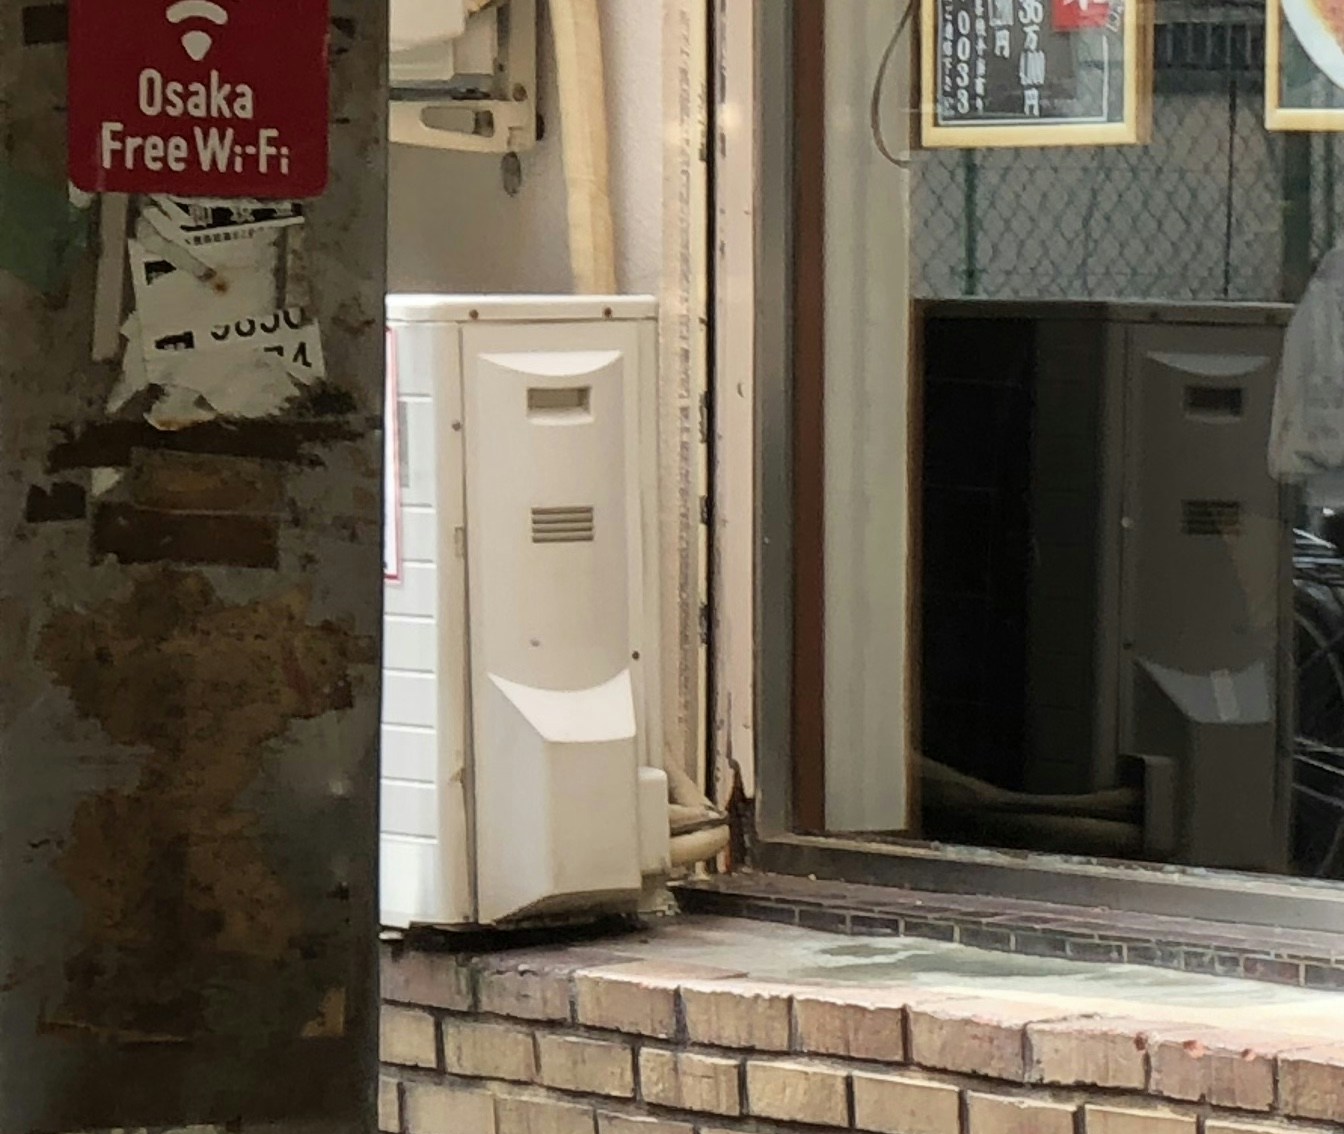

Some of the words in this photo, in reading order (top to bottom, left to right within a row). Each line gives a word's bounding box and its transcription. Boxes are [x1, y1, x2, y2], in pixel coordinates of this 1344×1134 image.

[138, 67, 254, 119] Osaka
[101, 121, 188, 172] Free
[193, 126, 290, 175] Wi-Fi
